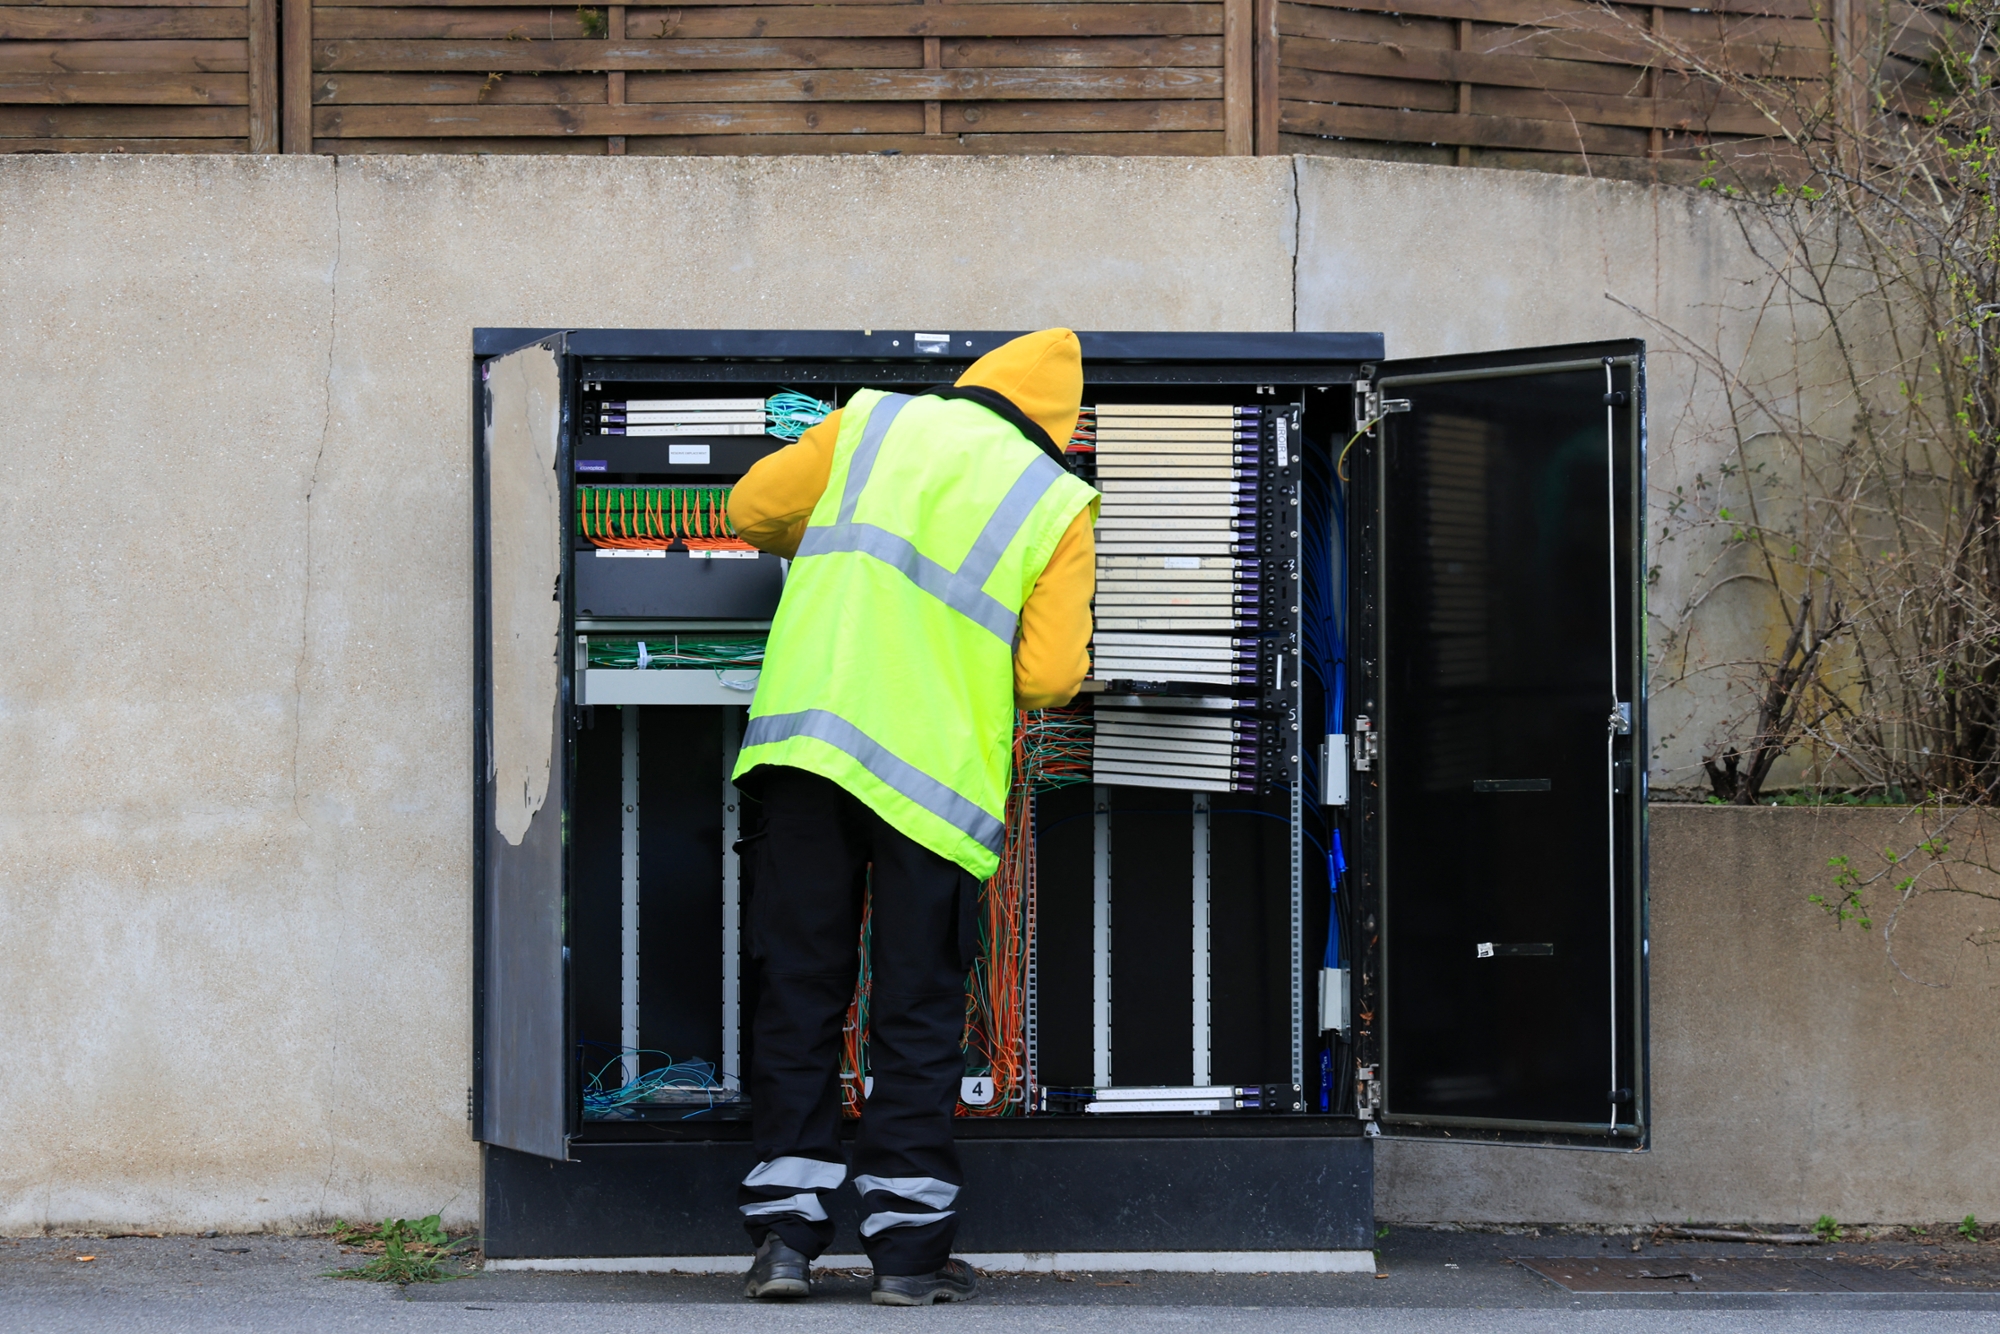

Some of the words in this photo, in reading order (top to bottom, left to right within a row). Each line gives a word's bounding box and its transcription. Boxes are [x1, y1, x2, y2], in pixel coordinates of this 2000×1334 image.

[1277, 420, 1287, 453] TIROIR
[1288, 558, 1295, 571] 3
[1288, 708, 1296, 721] 5
[972, 1081, 983, 1097] 4
